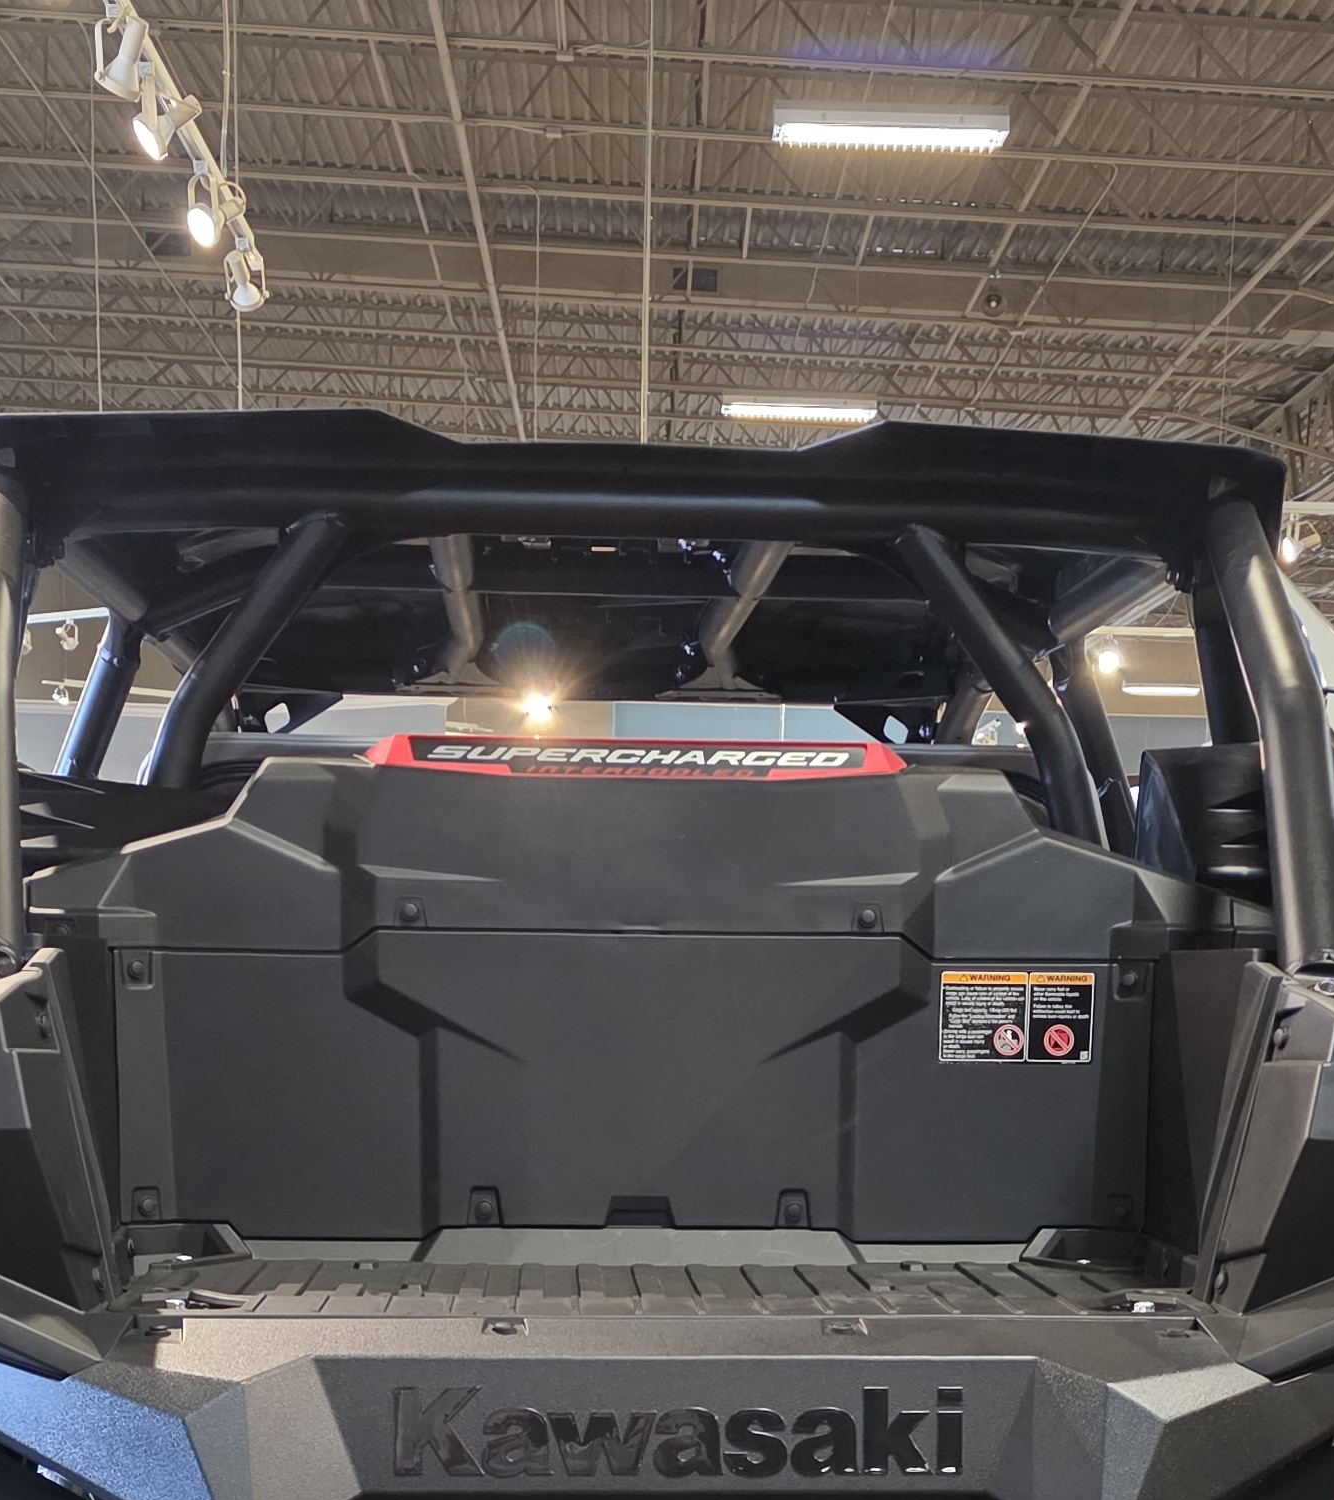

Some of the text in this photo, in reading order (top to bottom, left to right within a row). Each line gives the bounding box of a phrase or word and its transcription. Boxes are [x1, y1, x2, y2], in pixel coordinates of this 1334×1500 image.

[427, 744, 850, 768] SUPERCHARGED
[524, 764, 756, 779] INTERCOOLED
[969, 974, 1011, 982] WARNING
[393, 1384, 966, 1479] Kawasaki
